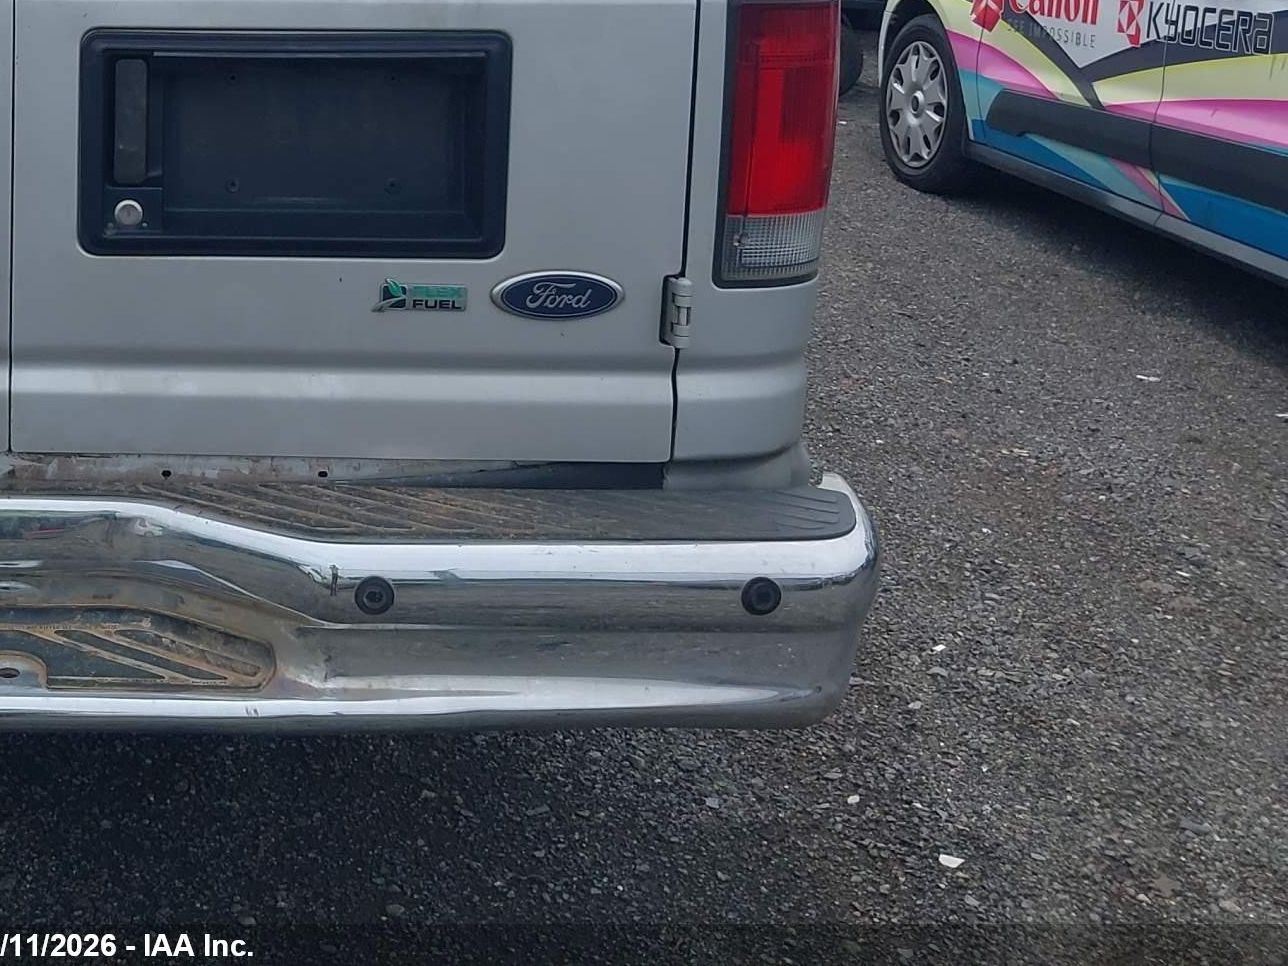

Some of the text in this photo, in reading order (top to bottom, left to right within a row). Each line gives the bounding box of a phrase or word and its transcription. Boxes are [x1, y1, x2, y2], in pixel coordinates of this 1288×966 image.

[412, 286, 462, 298] FLEX
[525, 282, 593, 309] Ford
[412, 299, 462, 310] FUEL
